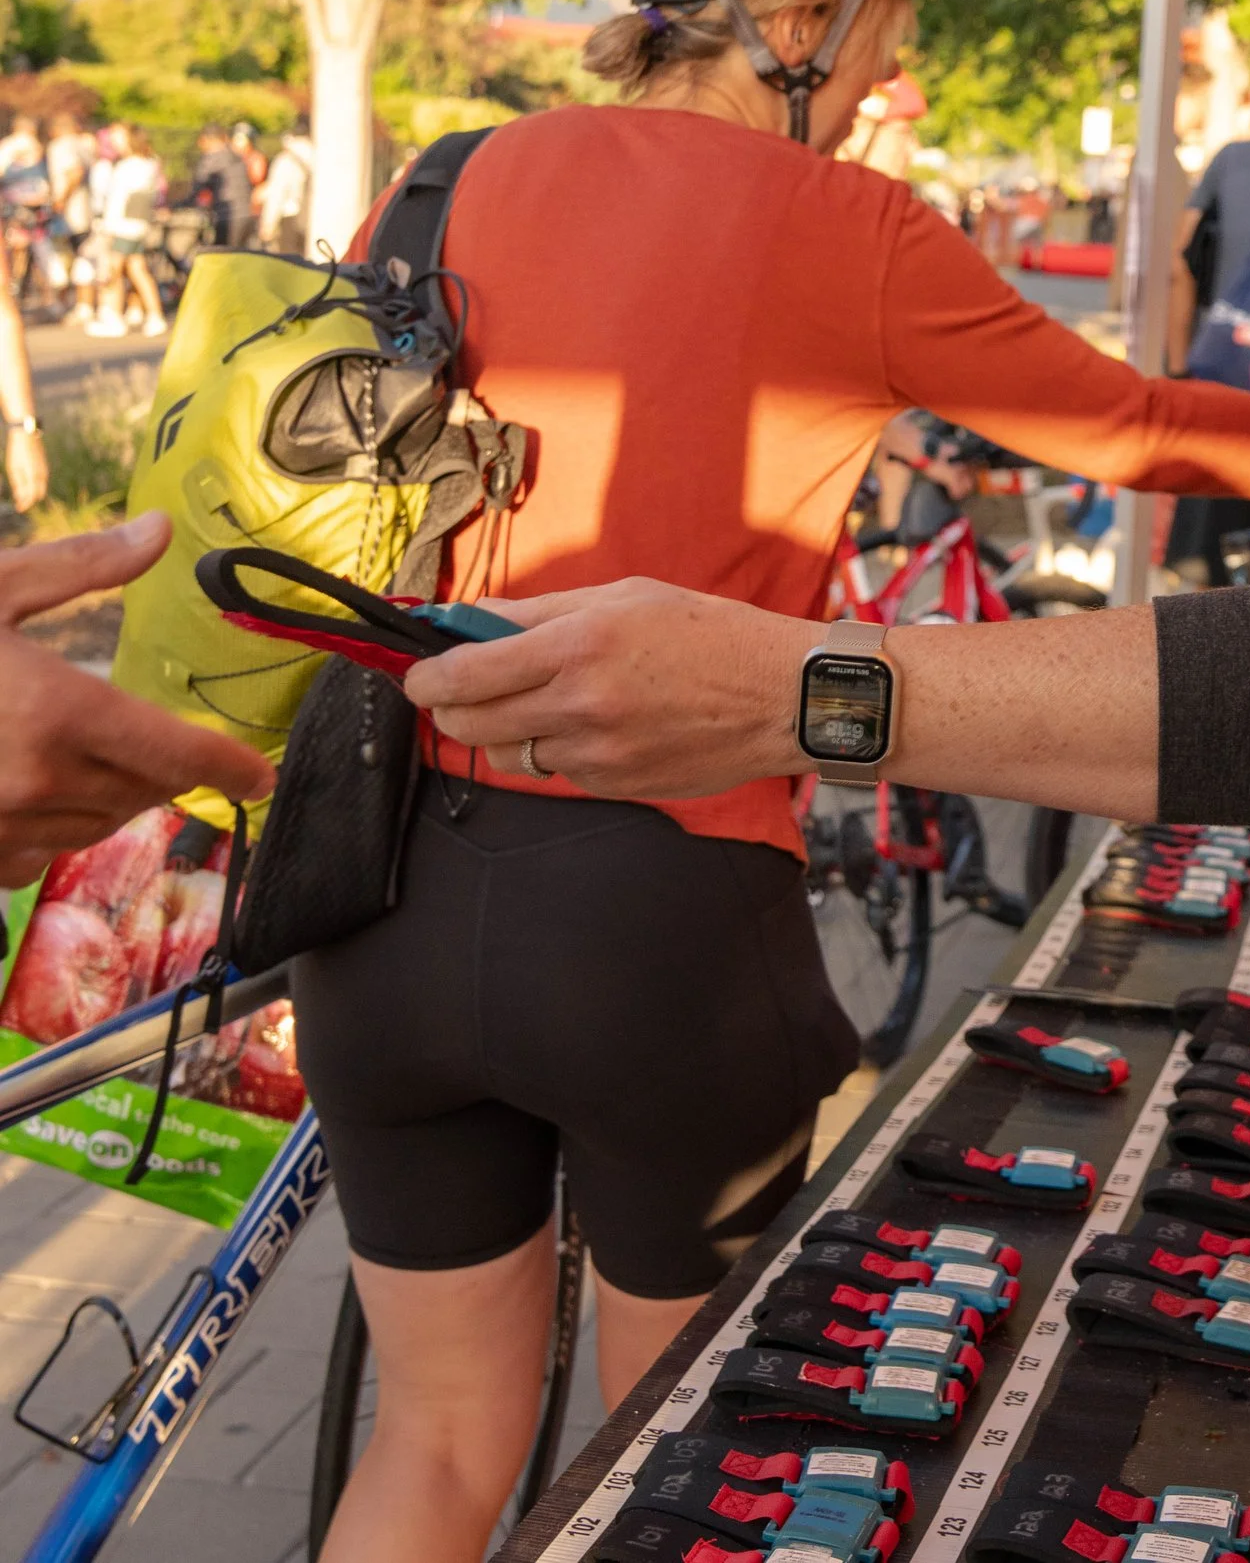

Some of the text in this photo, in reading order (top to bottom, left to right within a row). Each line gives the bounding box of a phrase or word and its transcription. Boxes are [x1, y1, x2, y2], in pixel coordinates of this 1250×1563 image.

[91, 1140, 129, 1159] on
[135, 1143, 222, 1177] oods
[128, 1143, 332, 1445] TREK
[1035, 1320, 1060, 1336] 128
[707, 1350, 730, 1368] 106
[748, 1353, 783, 1379] 105
[1016, 1354, 1042, 1371] 127
[669, 1387, 698, 1405] 105
[1003, 1390, 1030, 1407] 126
[637, 1427, 668, 1447] 104
[981, 1428, 1010, 1447] 125
[667, 1437, 706, 1464] 103
[603, 1471, 634, 1491] 103
[958, 1470, 988, 1490] 124
[566, 1515, 602, 1538] 102
[937, 1516, 968, 1537] 123
[625, 1524, 672, 1551] 101
